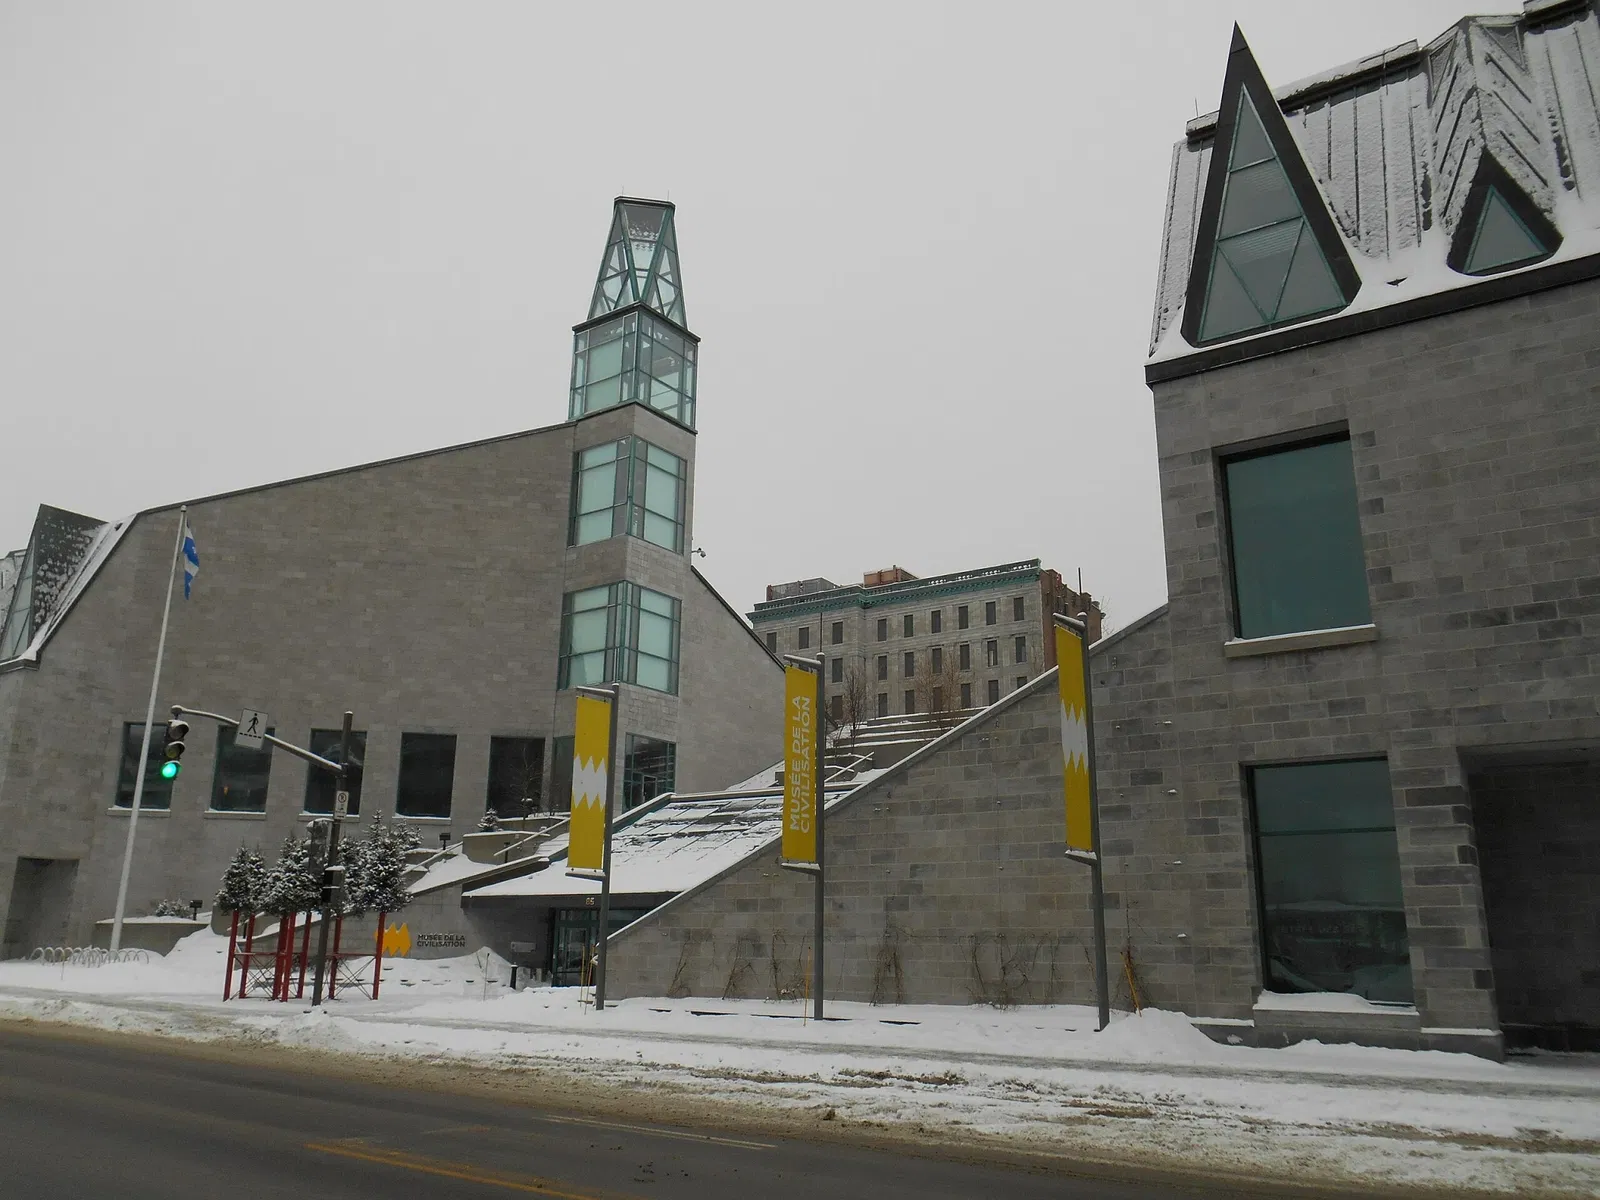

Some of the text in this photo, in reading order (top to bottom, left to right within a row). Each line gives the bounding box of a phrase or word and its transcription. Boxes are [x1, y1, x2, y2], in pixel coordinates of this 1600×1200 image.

[789, 695, 801, 831] MUSÉE DE LA
[801, 696, 811, 833] CIVILISATION
[417, 933, 442, 941] MUSÉE
